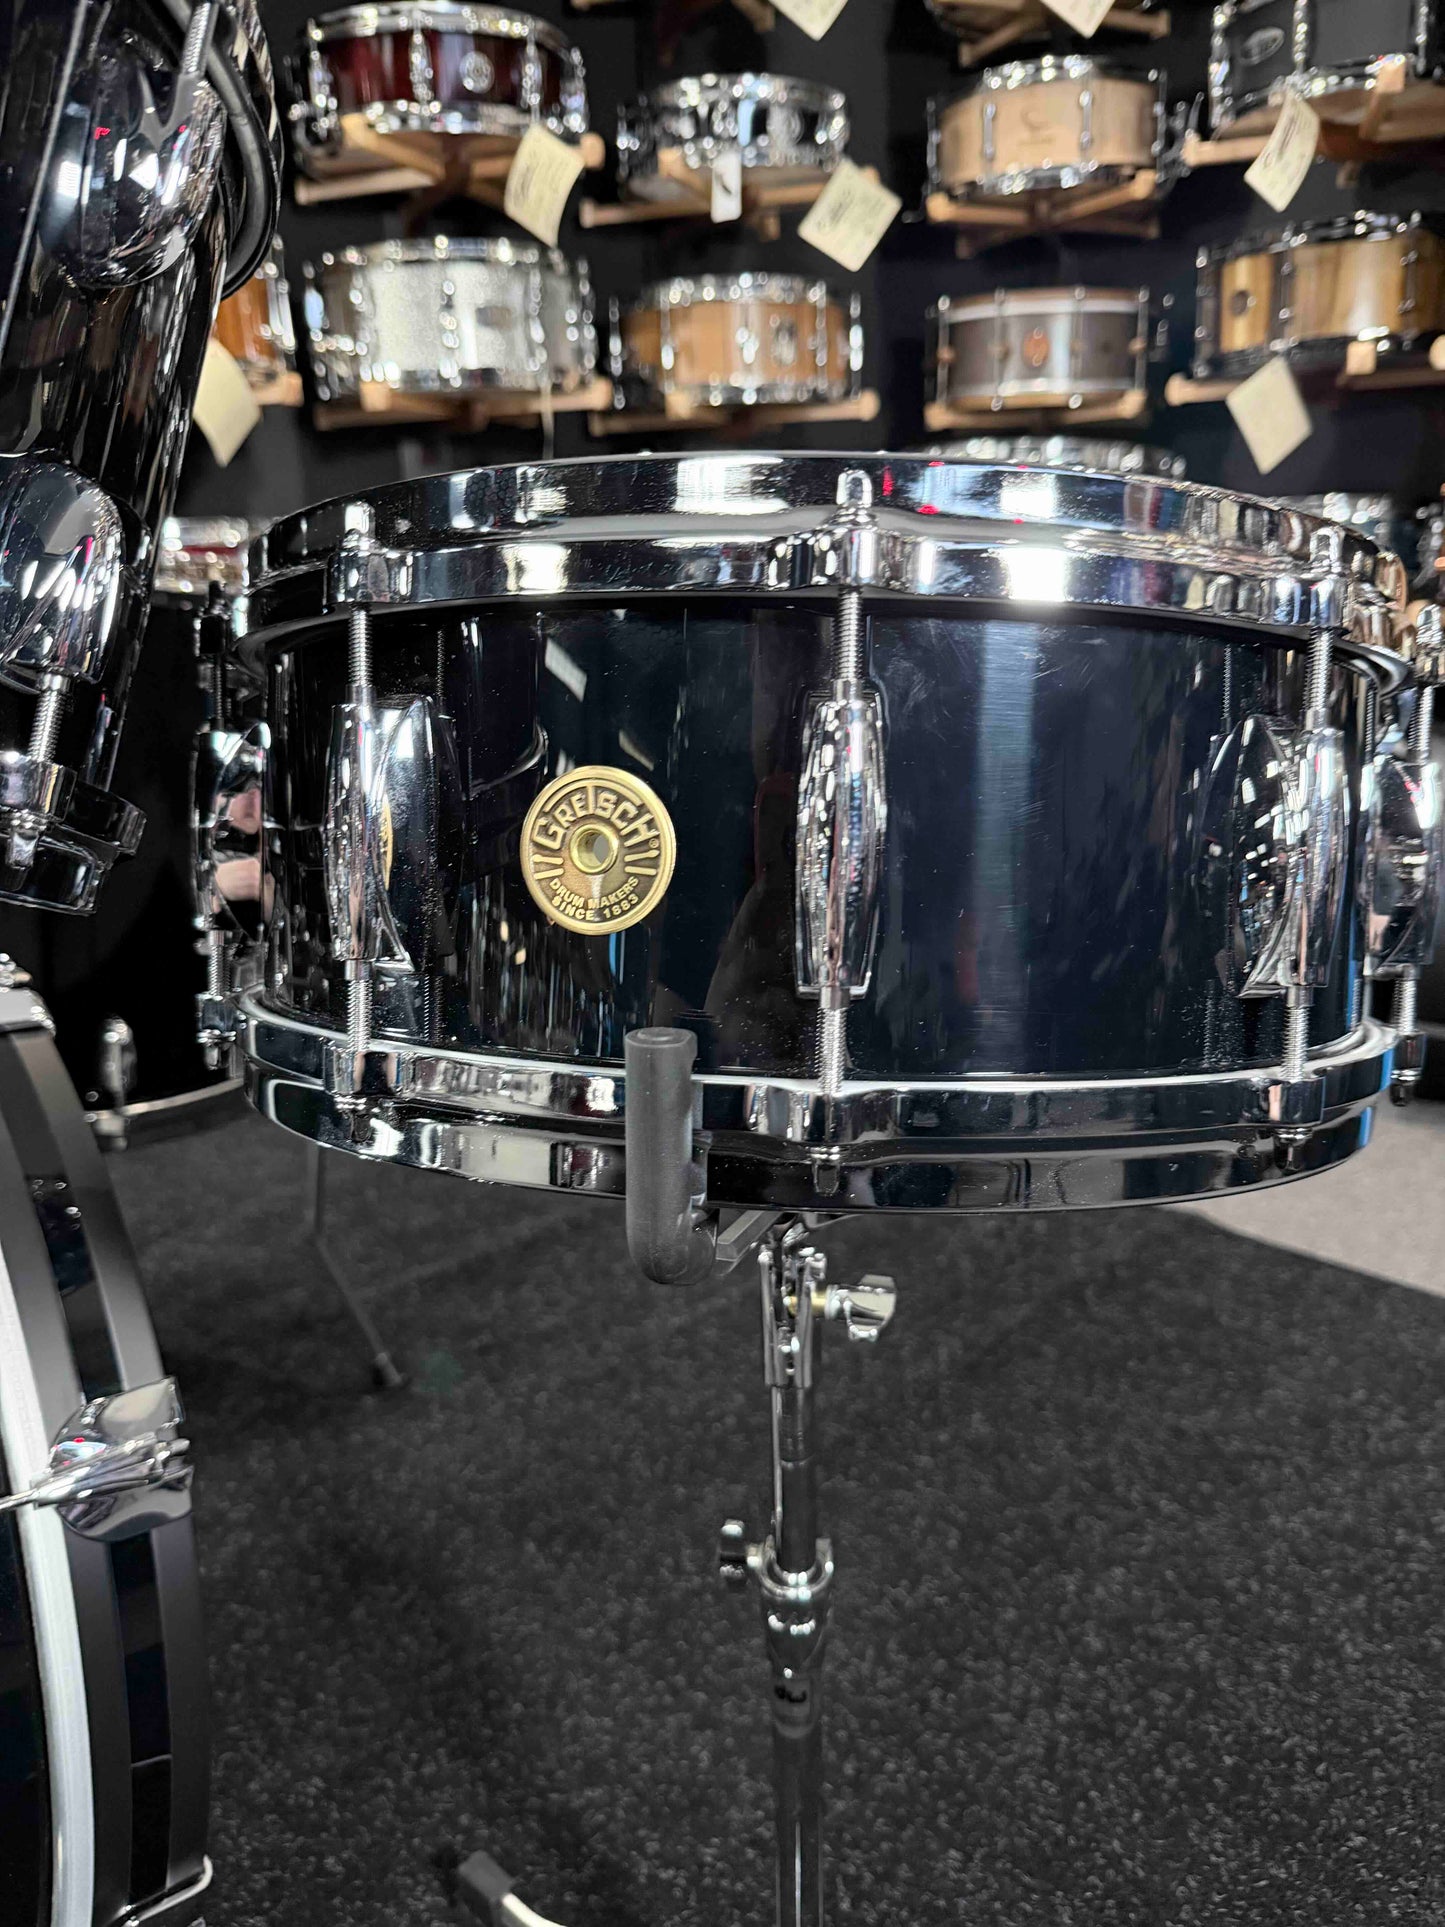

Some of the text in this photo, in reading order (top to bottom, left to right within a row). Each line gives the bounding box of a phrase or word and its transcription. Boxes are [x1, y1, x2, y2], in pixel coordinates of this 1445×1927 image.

[532, 778, 660, 850] GRETSCH
[549, 876, 639, 909] DRUM MAKERS
[551, 893, 639, 921] SINCE 1883
